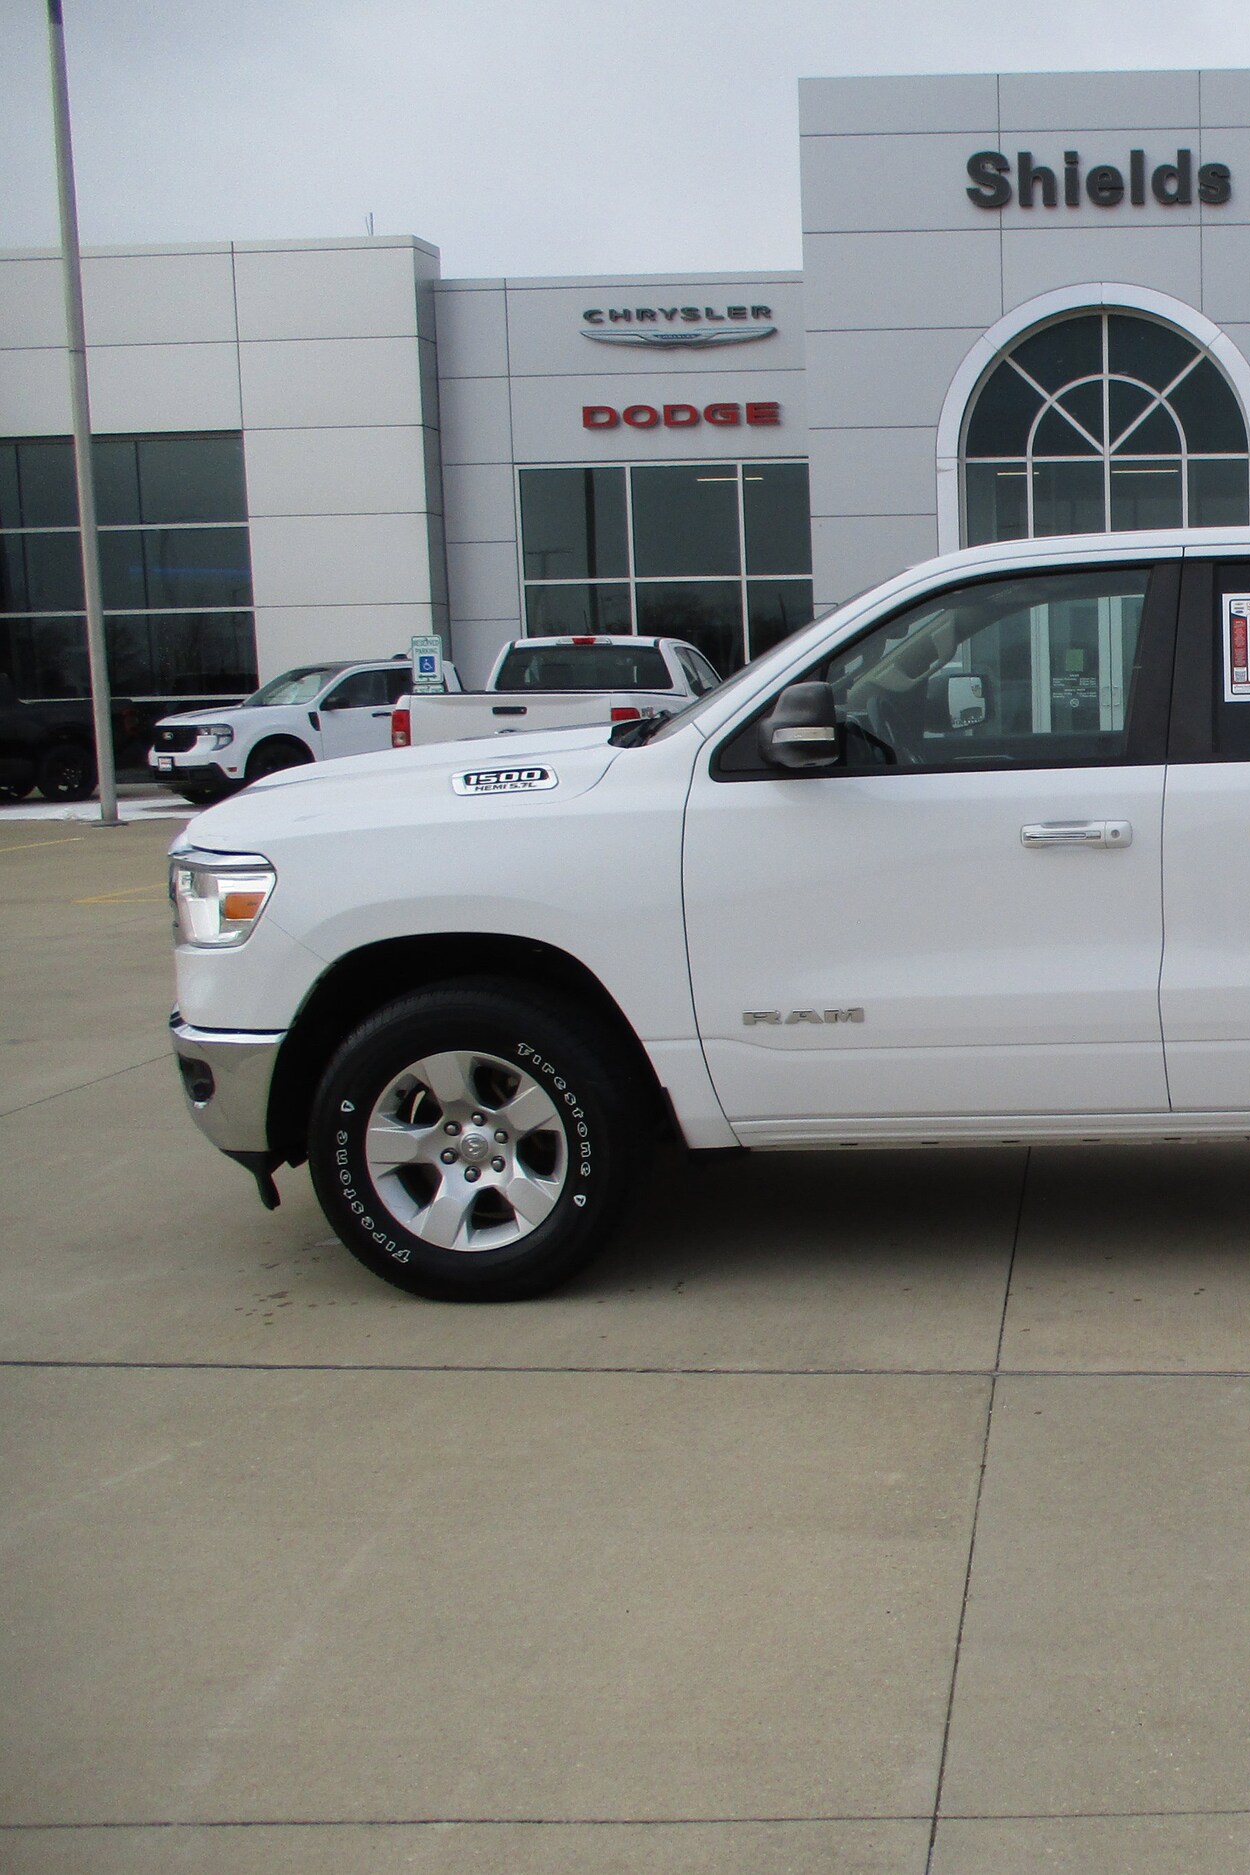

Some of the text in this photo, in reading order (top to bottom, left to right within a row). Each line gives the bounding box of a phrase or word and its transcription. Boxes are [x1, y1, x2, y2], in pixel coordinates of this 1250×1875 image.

[966, 149, 1232, 208] Shields
[583, 305, 772, 323] CHRYSLER
[582, 402, 780, 428] DODGE
[469, 770, 541, 785] 1500
[475, 781, 537, 792] HEMI 5.7L
[742, 1007, 865, 1026] RAM
[517, 1042, 592, 1178] Firestone
[335, 1129, 412, 1265] Firestone
